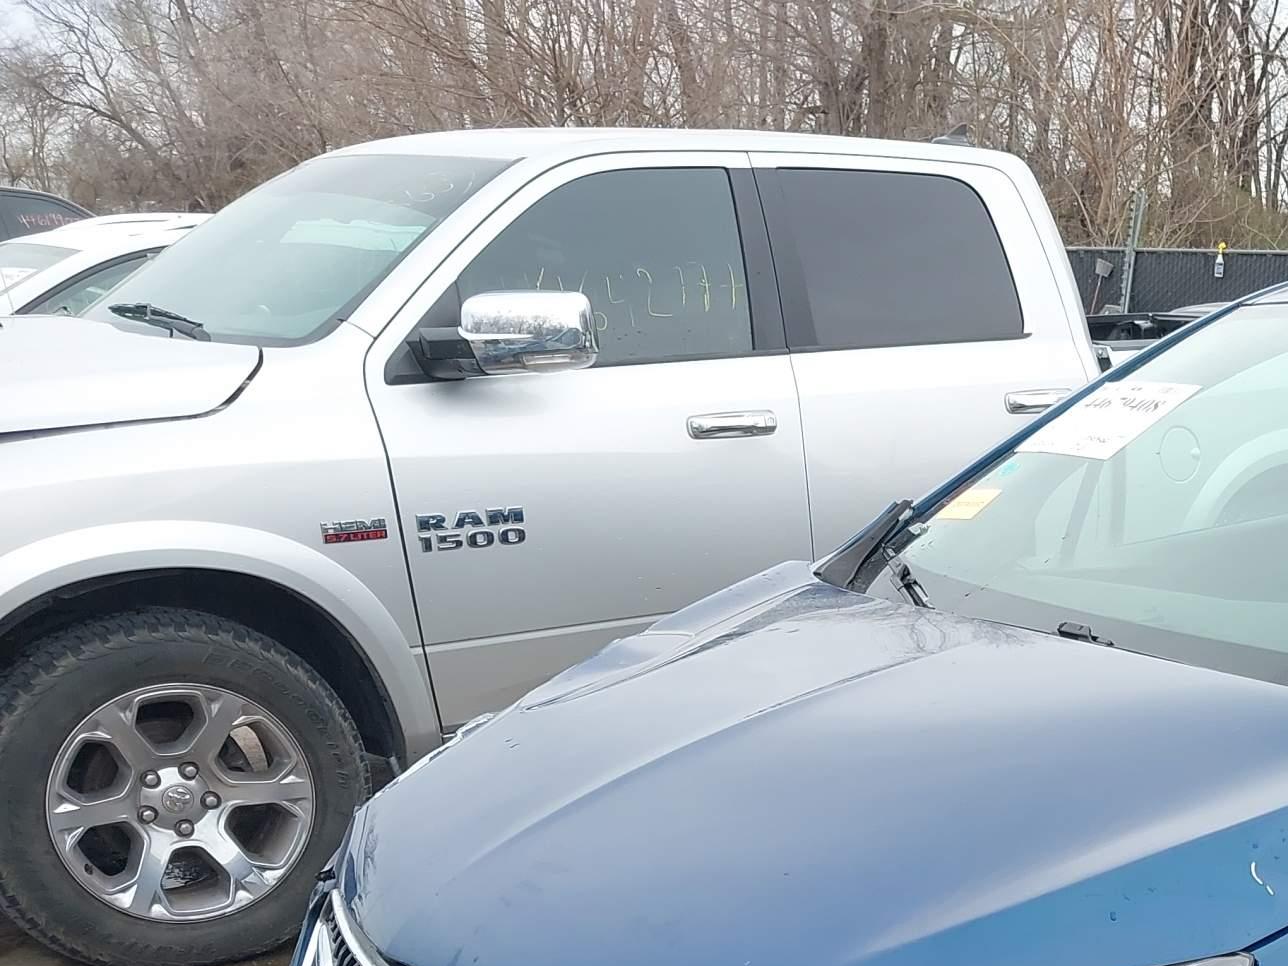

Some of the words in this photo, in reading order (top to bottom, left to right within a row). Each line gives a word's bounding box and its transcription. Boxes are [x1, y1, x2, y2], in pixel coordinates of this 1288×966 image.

[320, 518, 387, 534] HEMI
[415, 505, 526, 533] RAM
[326, 533, 349, 543] 5.7
[350, 529, 386, 542] LITER
[418, 526, 527, 553] 1500
